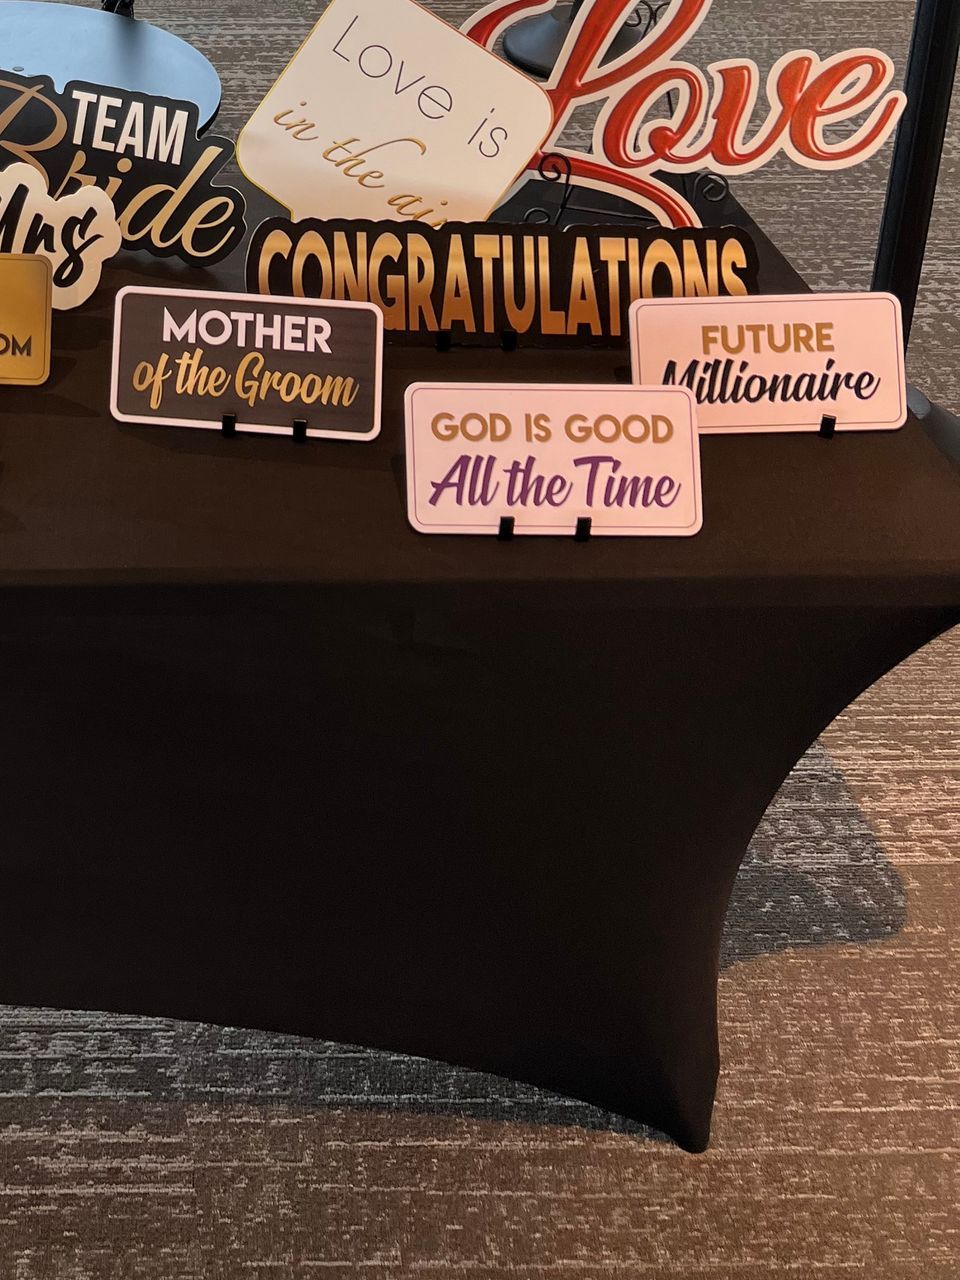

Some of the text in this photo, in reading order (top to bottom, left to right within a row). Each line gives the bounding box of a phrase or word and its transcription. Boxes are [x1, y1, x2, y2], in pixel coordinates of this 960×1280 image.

[332, 15, 508, 158] Love is
[70, 89, 189, 165] TEAM
[273, 100, 448, 228] in the ai
[258, 230, 748, 336] CONGRATULATIONS
[162, 307, 332, 354] MOTHER
[701, 322, 835, 355] FUTURE
[132, 347, 360, 410] of the Groom
[662, 358, 881, 405] Millionaire
[430, 412, 674, 444] GOD IS GOOD
[428, 454, 682, 508] All the Time
